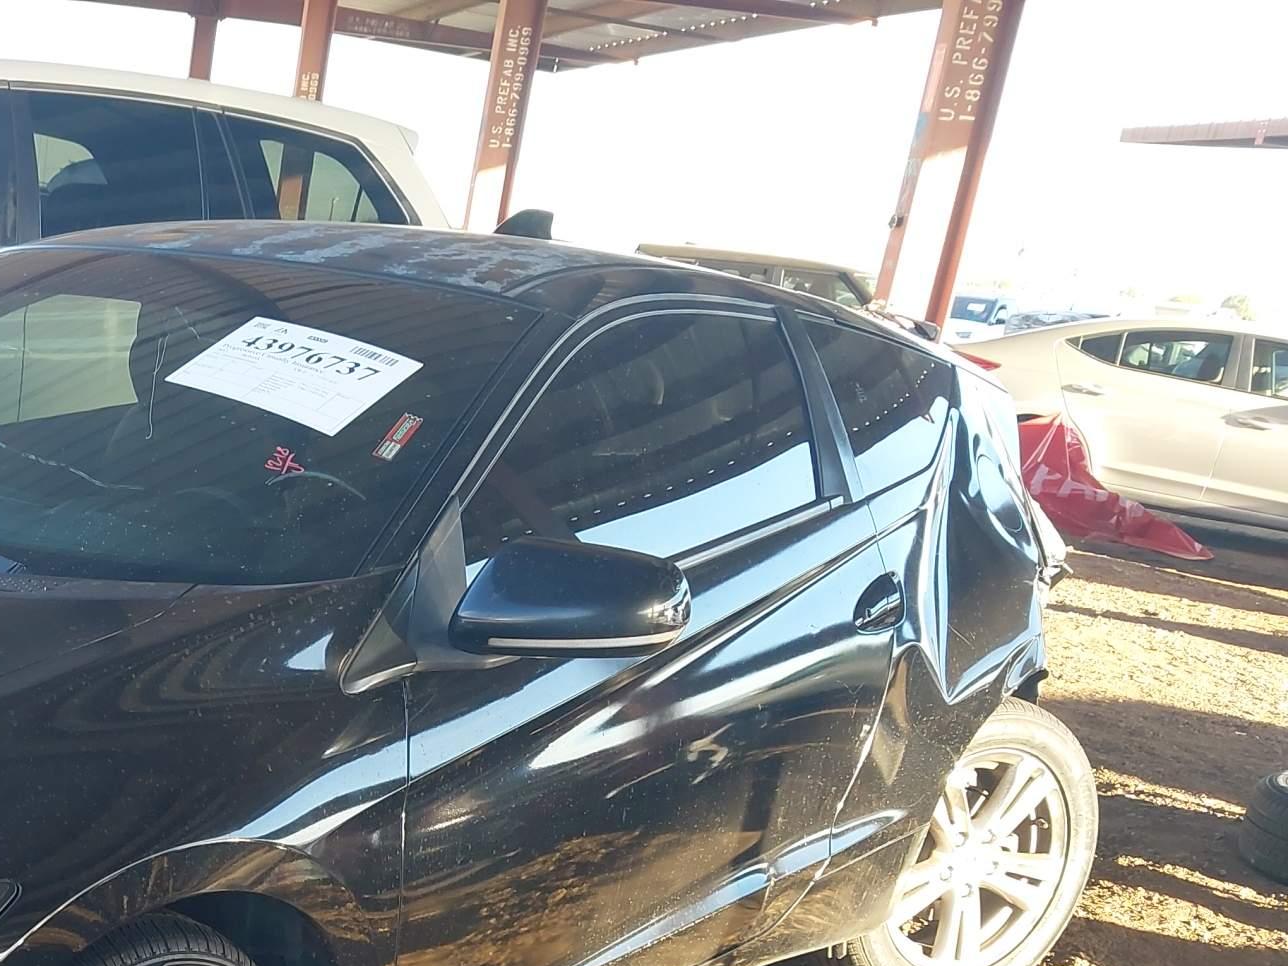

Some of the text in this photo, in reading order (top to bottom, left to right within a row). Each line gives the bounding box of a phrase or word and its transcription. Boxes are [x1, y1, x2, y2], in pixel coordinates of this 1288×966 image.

[488, 25, 521, 148] U.S. PREFAB INC.
[501, 27, 532, 148] 1-866-799-0969
[938, 0, 983, 121] U.S. PREF
[242, 336, 382, 381] 43976737
